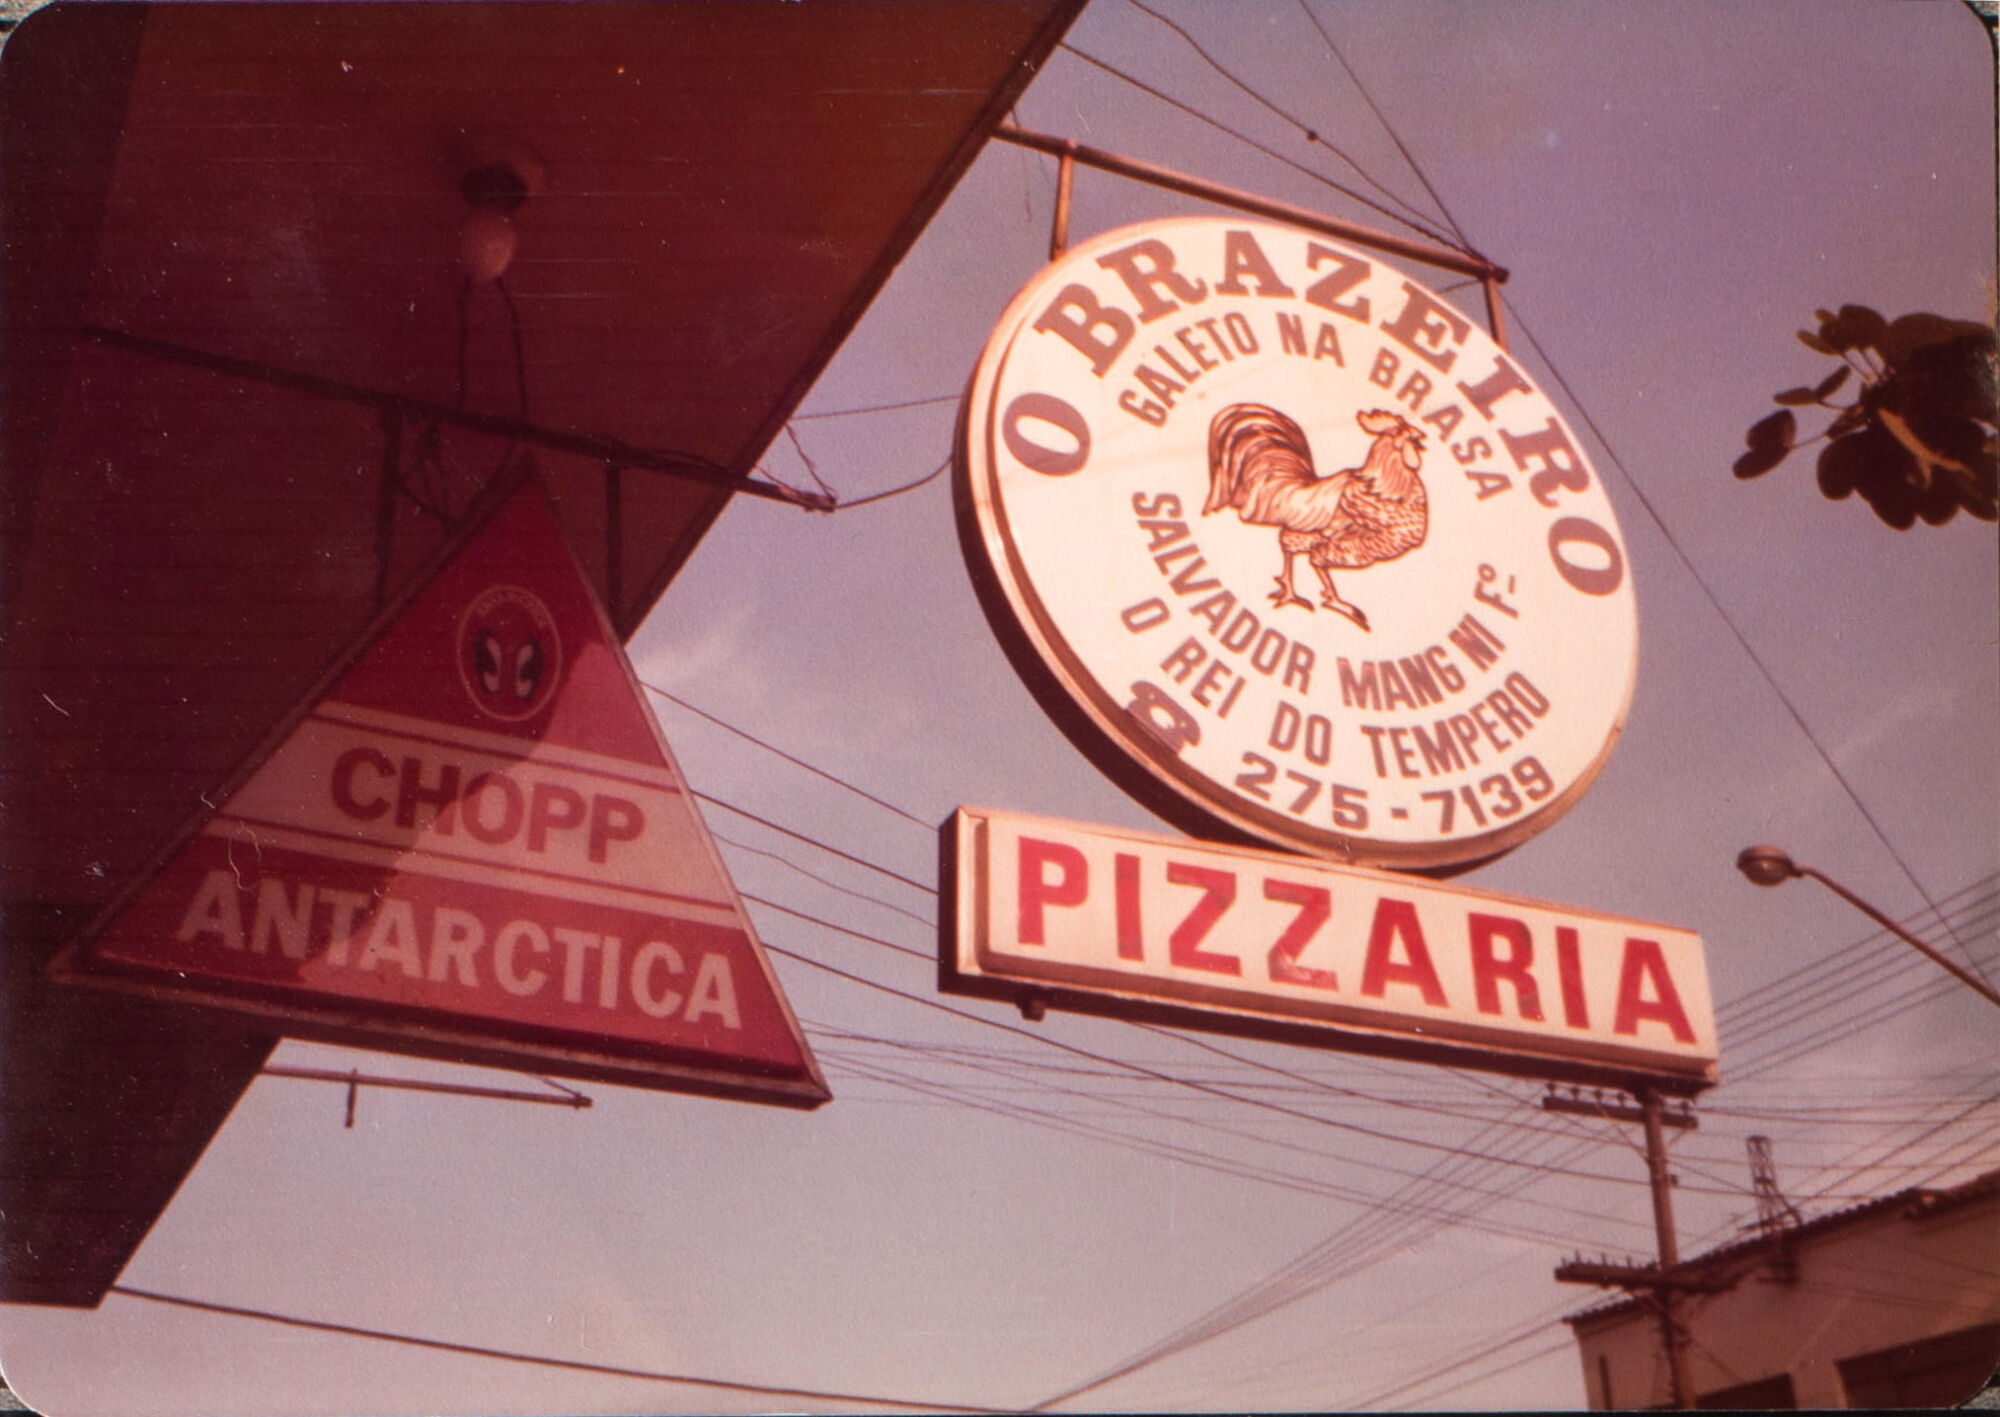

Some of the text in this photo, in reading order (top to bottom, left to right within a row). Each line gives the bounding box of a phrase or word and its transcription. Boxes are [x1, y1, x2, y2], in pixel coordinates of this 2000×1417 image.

[1002, 230, 1624, 597] O BRAZEIRO
[1118, 312, 1513, 501] GALETO NA BRASA
[1120, 597, 1550, 779] O REI DO TEMPERO
[1131, 492, 1316, 695] SALVADOR
[331, 746, 647, 865] CHOPP
[176, 869, 742, 1030] ANTARCTICA
[1016, 834, 1698, 1045] PIZZARIA
